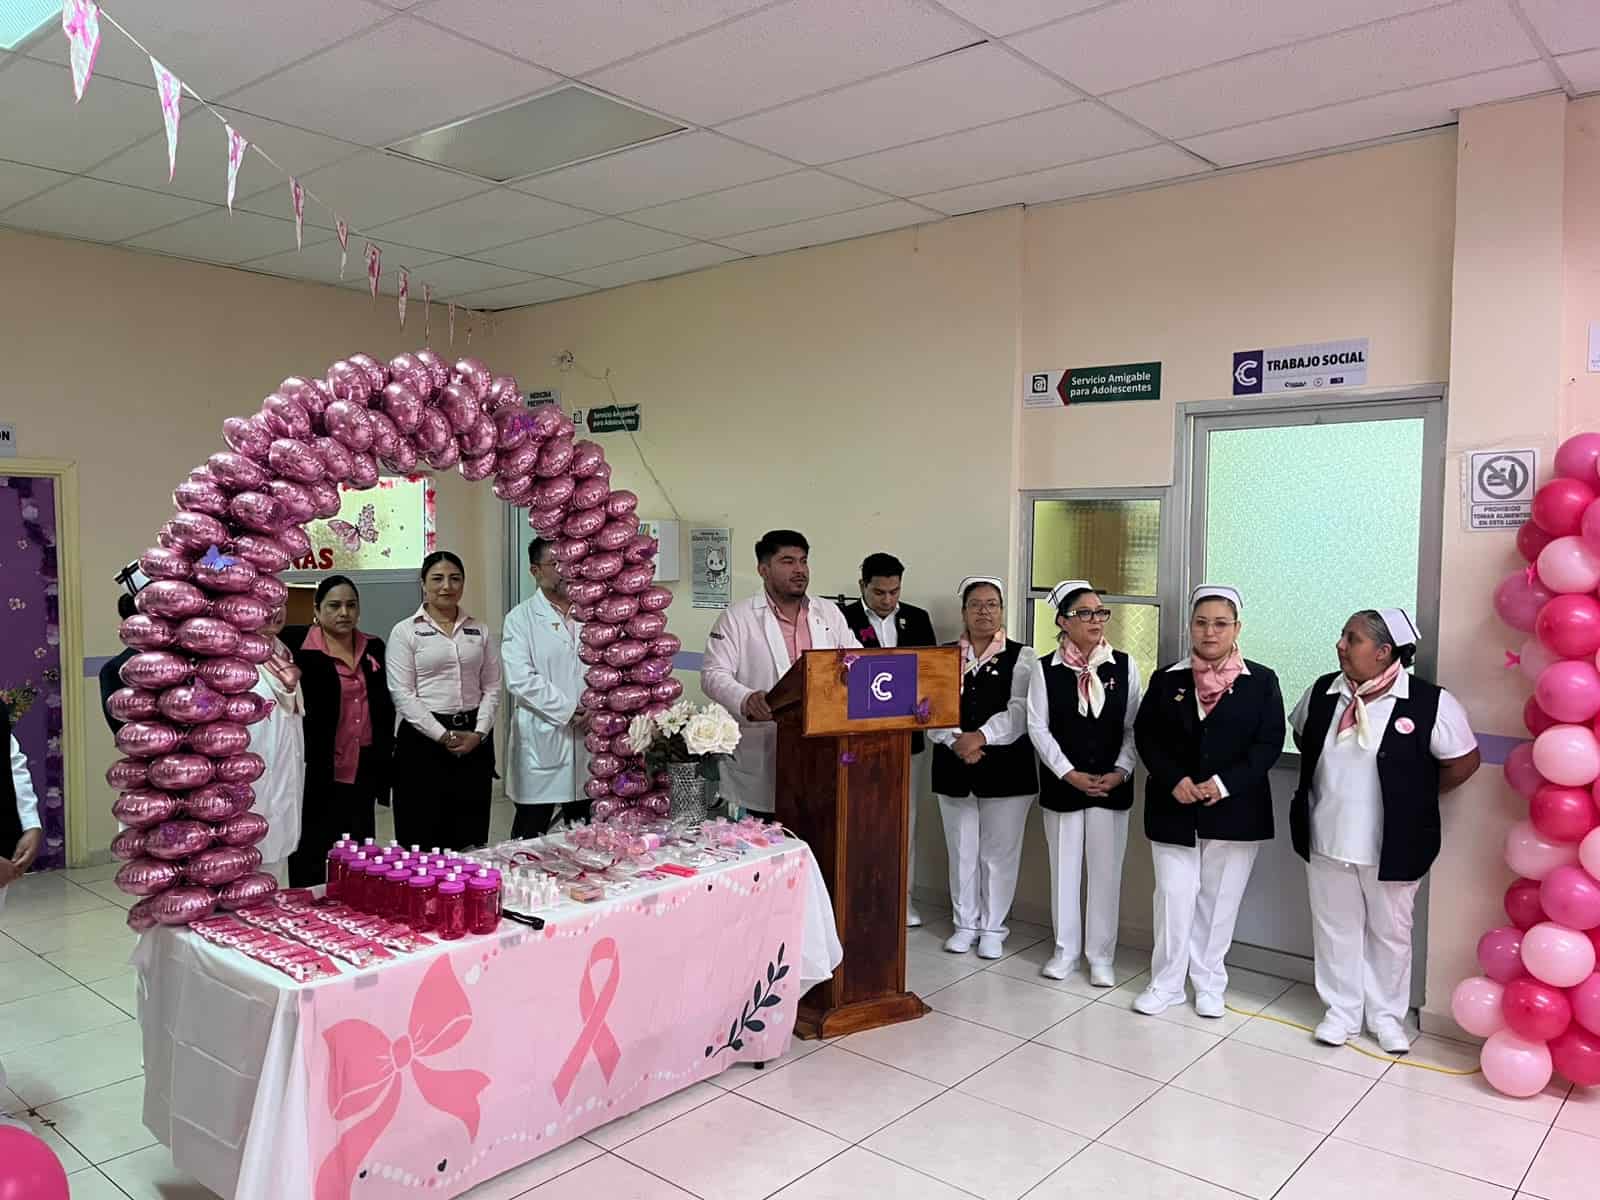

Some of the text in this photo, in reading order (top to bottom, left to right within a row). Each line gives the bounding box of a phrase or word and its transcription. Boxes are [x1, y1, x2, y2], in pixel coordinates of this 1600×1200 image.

[1266, 351, 1365, 371] TRABAJO SOCIAL
[1071, 371, 1151, 386] Servicio Amigable
[1070, 382, 1152, 398] para Adolescentes
